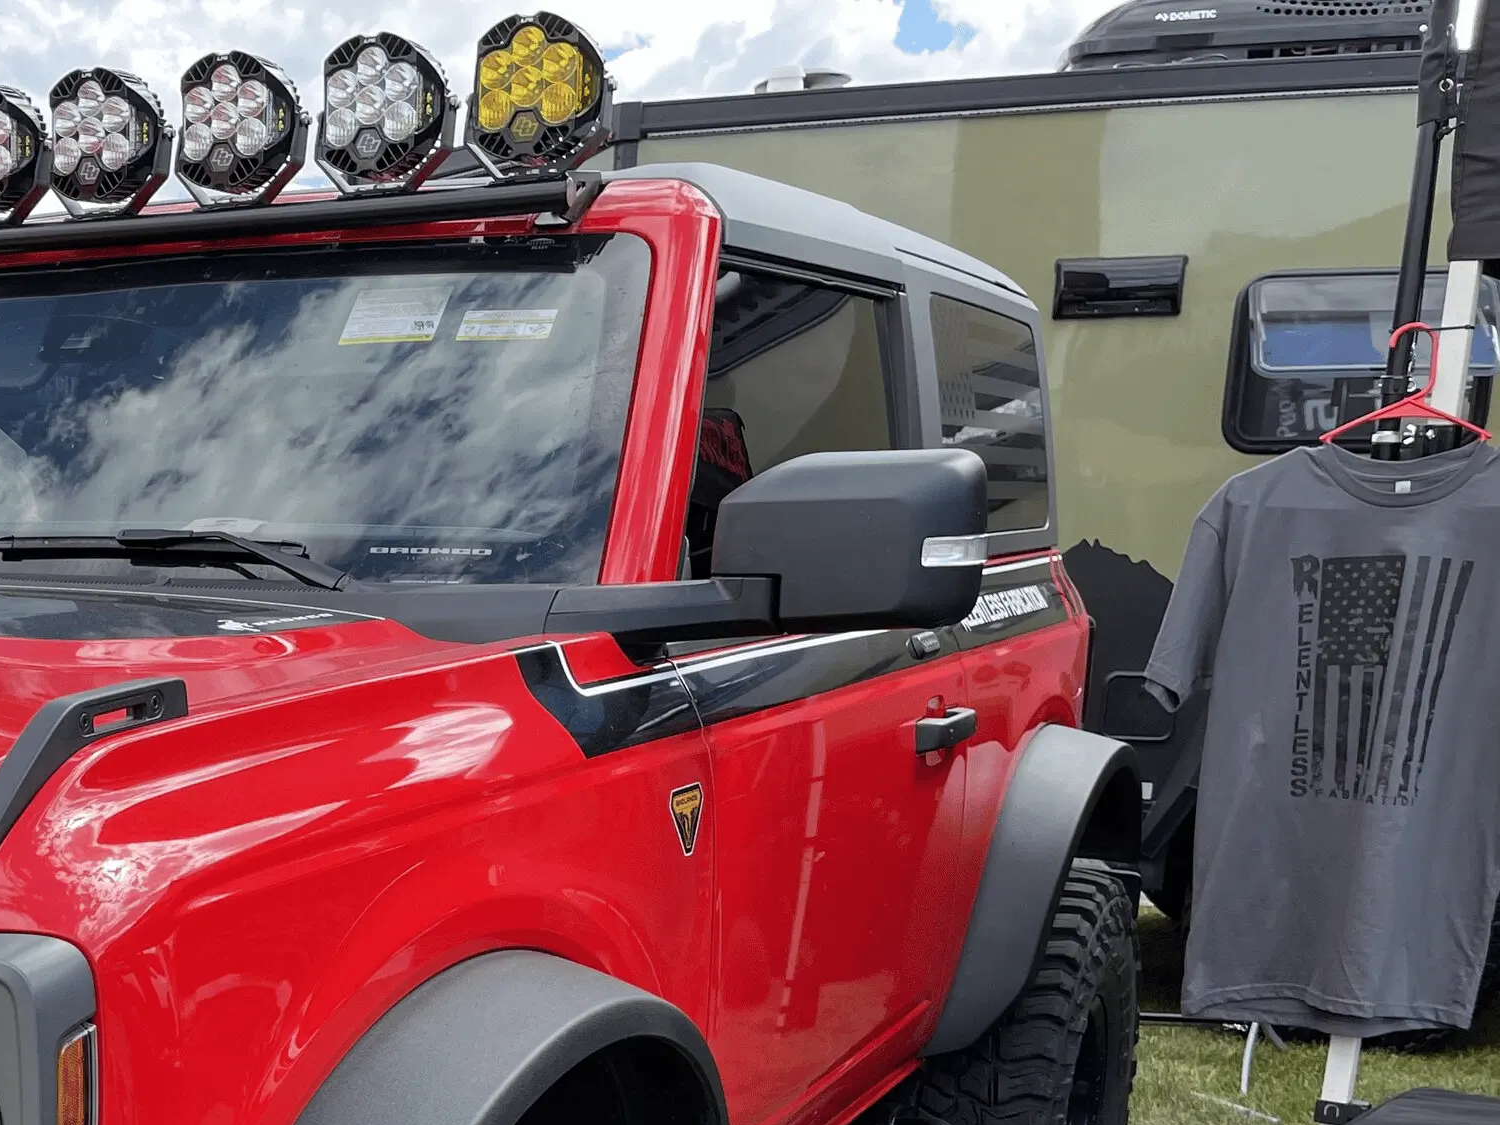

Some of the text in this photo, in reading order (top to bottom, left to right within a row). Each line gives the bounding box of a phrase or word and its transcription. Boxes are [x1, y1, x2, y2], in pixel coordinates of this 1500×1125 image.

[1169, 9, 1217, 21] DOMETIC
[370, 546, 493, 556] BRONCO
[1290, 554, 1321, 798] RELENTLESS
